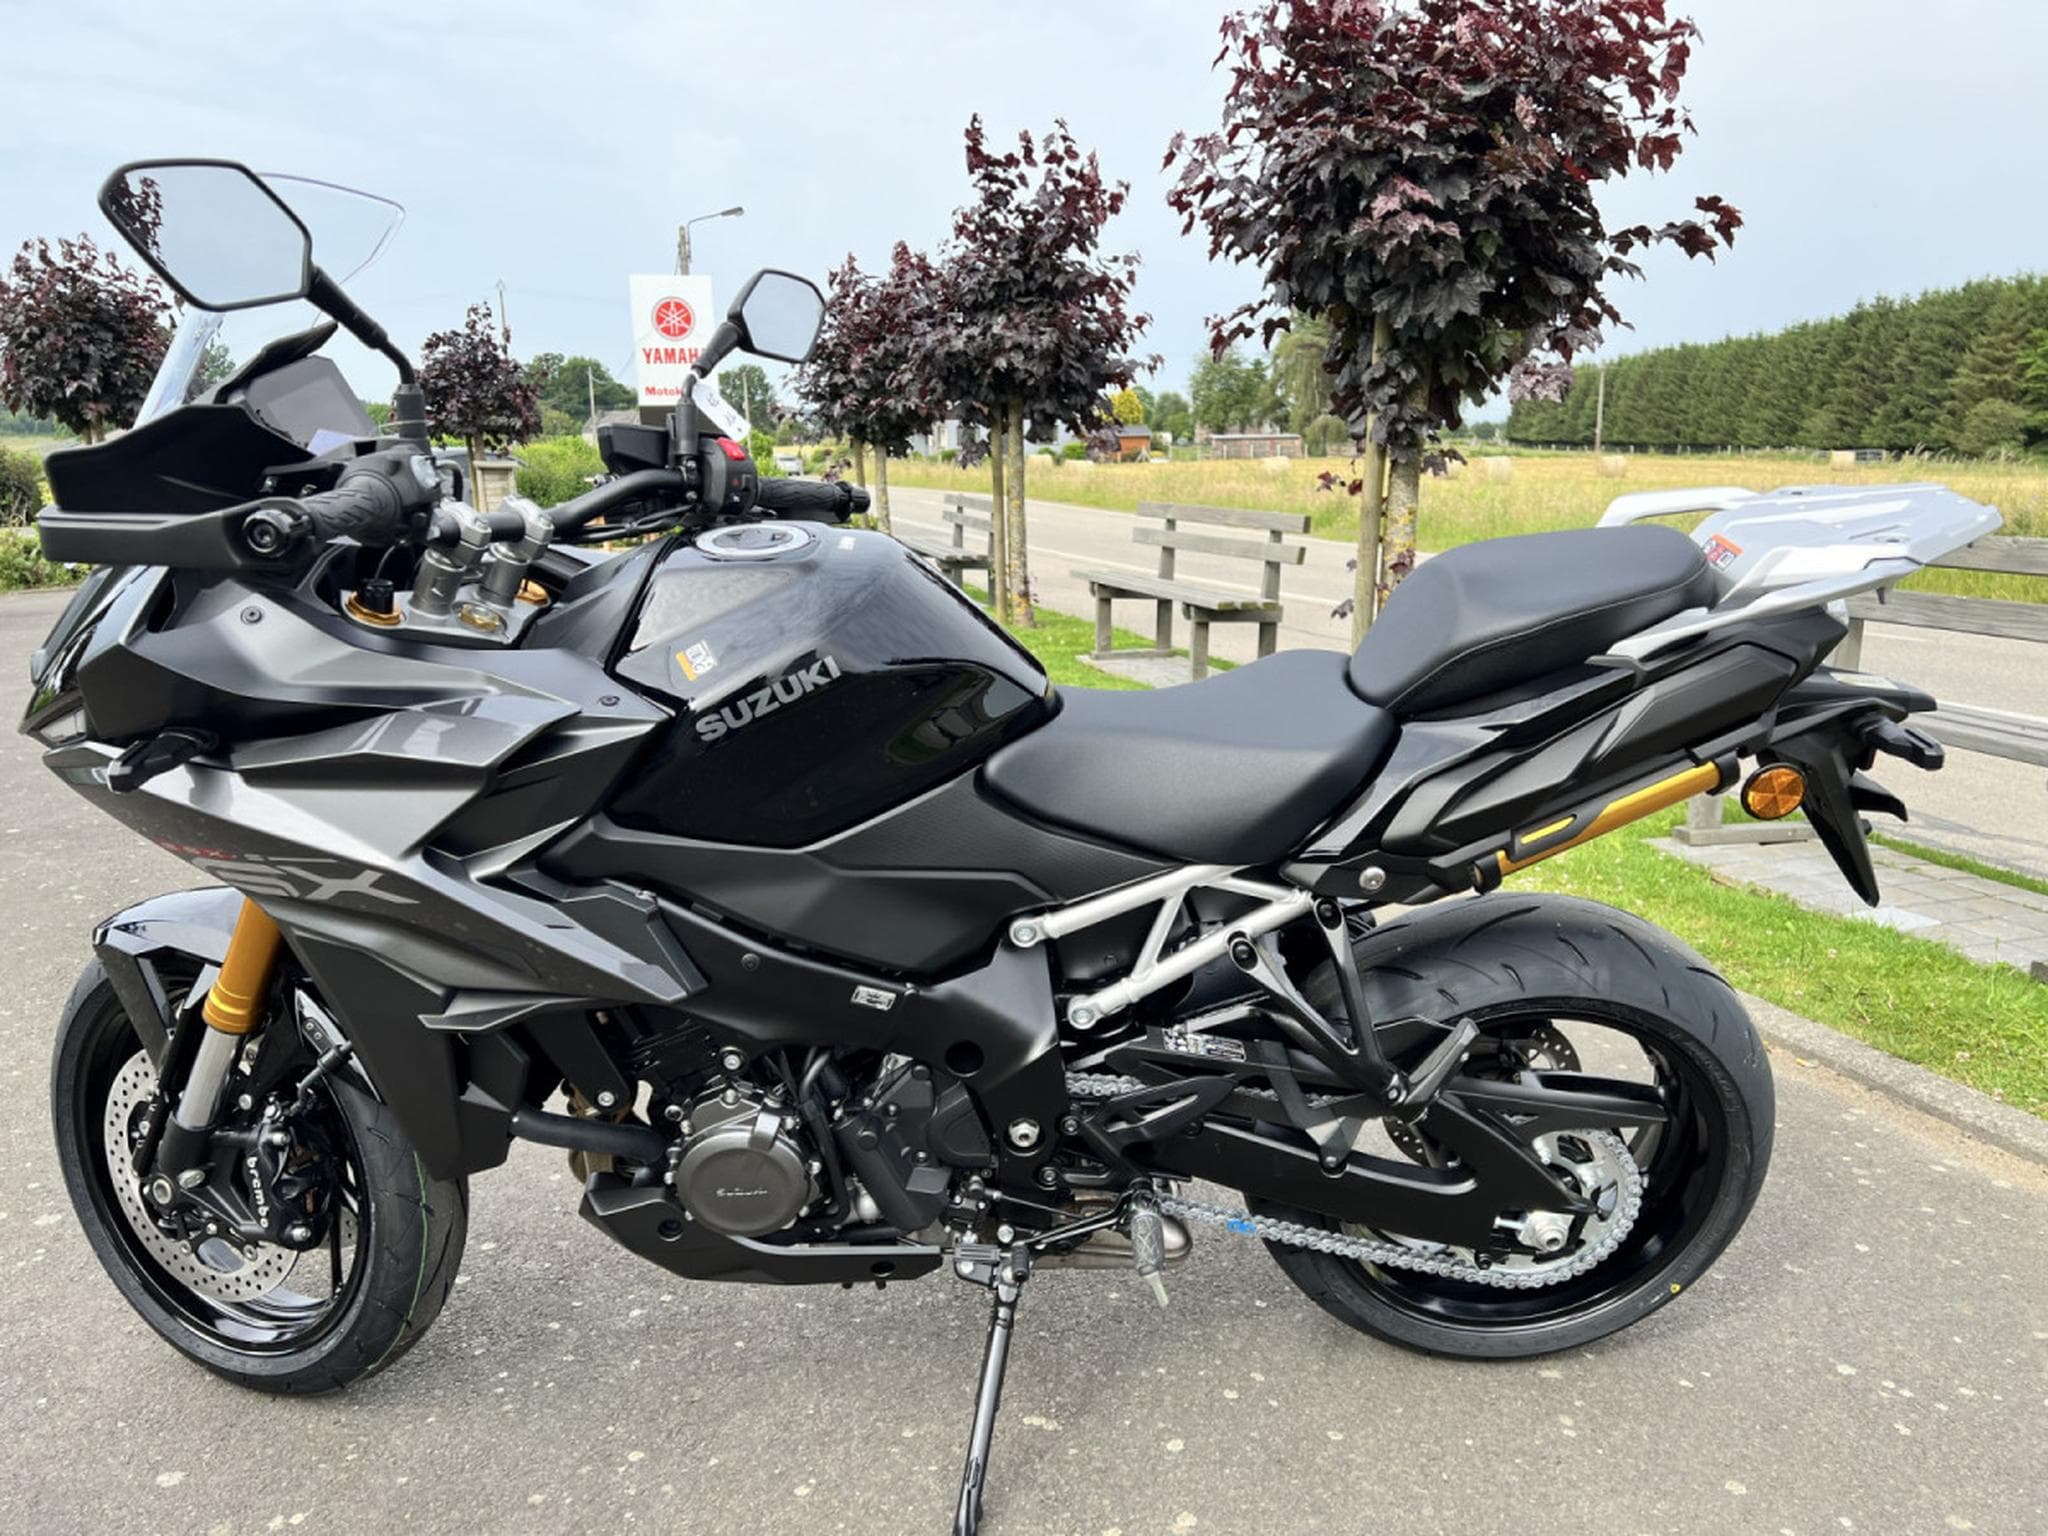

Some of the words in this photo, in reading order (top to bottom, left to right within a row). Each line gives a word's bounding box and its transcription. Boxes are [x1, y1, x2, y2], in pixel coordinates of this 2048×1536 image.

[642, 347, 704, 365] YAMAH
[695, 655, 842, 742] SUZUKI
[246, 1156, 270, 1229] brembo
